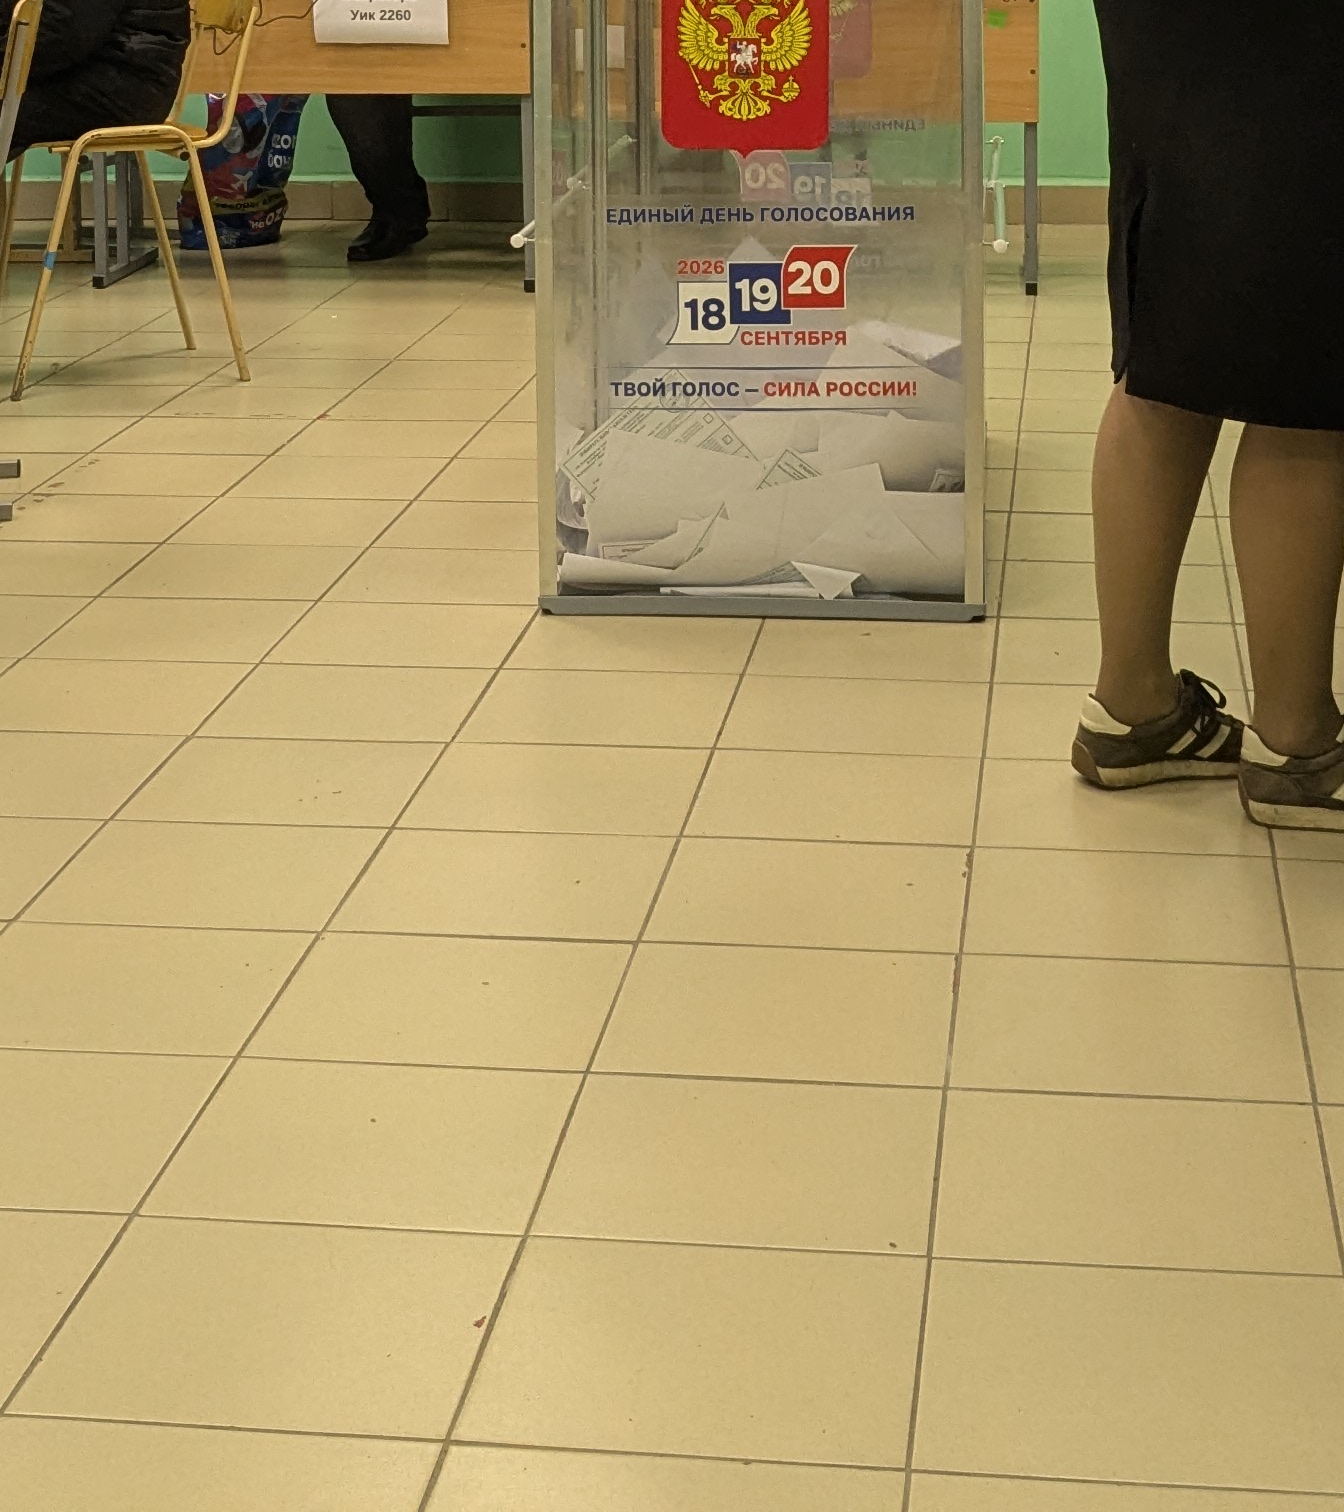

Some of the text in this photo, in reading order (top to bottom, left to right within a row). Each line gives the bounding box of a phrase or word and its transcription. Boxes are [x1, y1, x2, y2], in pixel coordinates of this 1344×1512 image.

[350, 9, 412, 21] Уик 2260
[606, 204, 915, 226] ЕДИНЫЙ ДЕНЬ ГОЛОСОВАНИЯ
[677, 259, 725, 275] 2026
[683, 297, 727, 331] 18
[735, 278, 778, 312] 19
[787, 260, 840, 295] 20
[740, 330, 847, 346] СЕНТЯБРЯ
[610, 377, 670, 397] ТВОЙ
[672, 381, 740, 398] ГОЛОС
[763, 381, 819, 398] СИЛА
[826, 381, 917, 397] РОССИИ!
